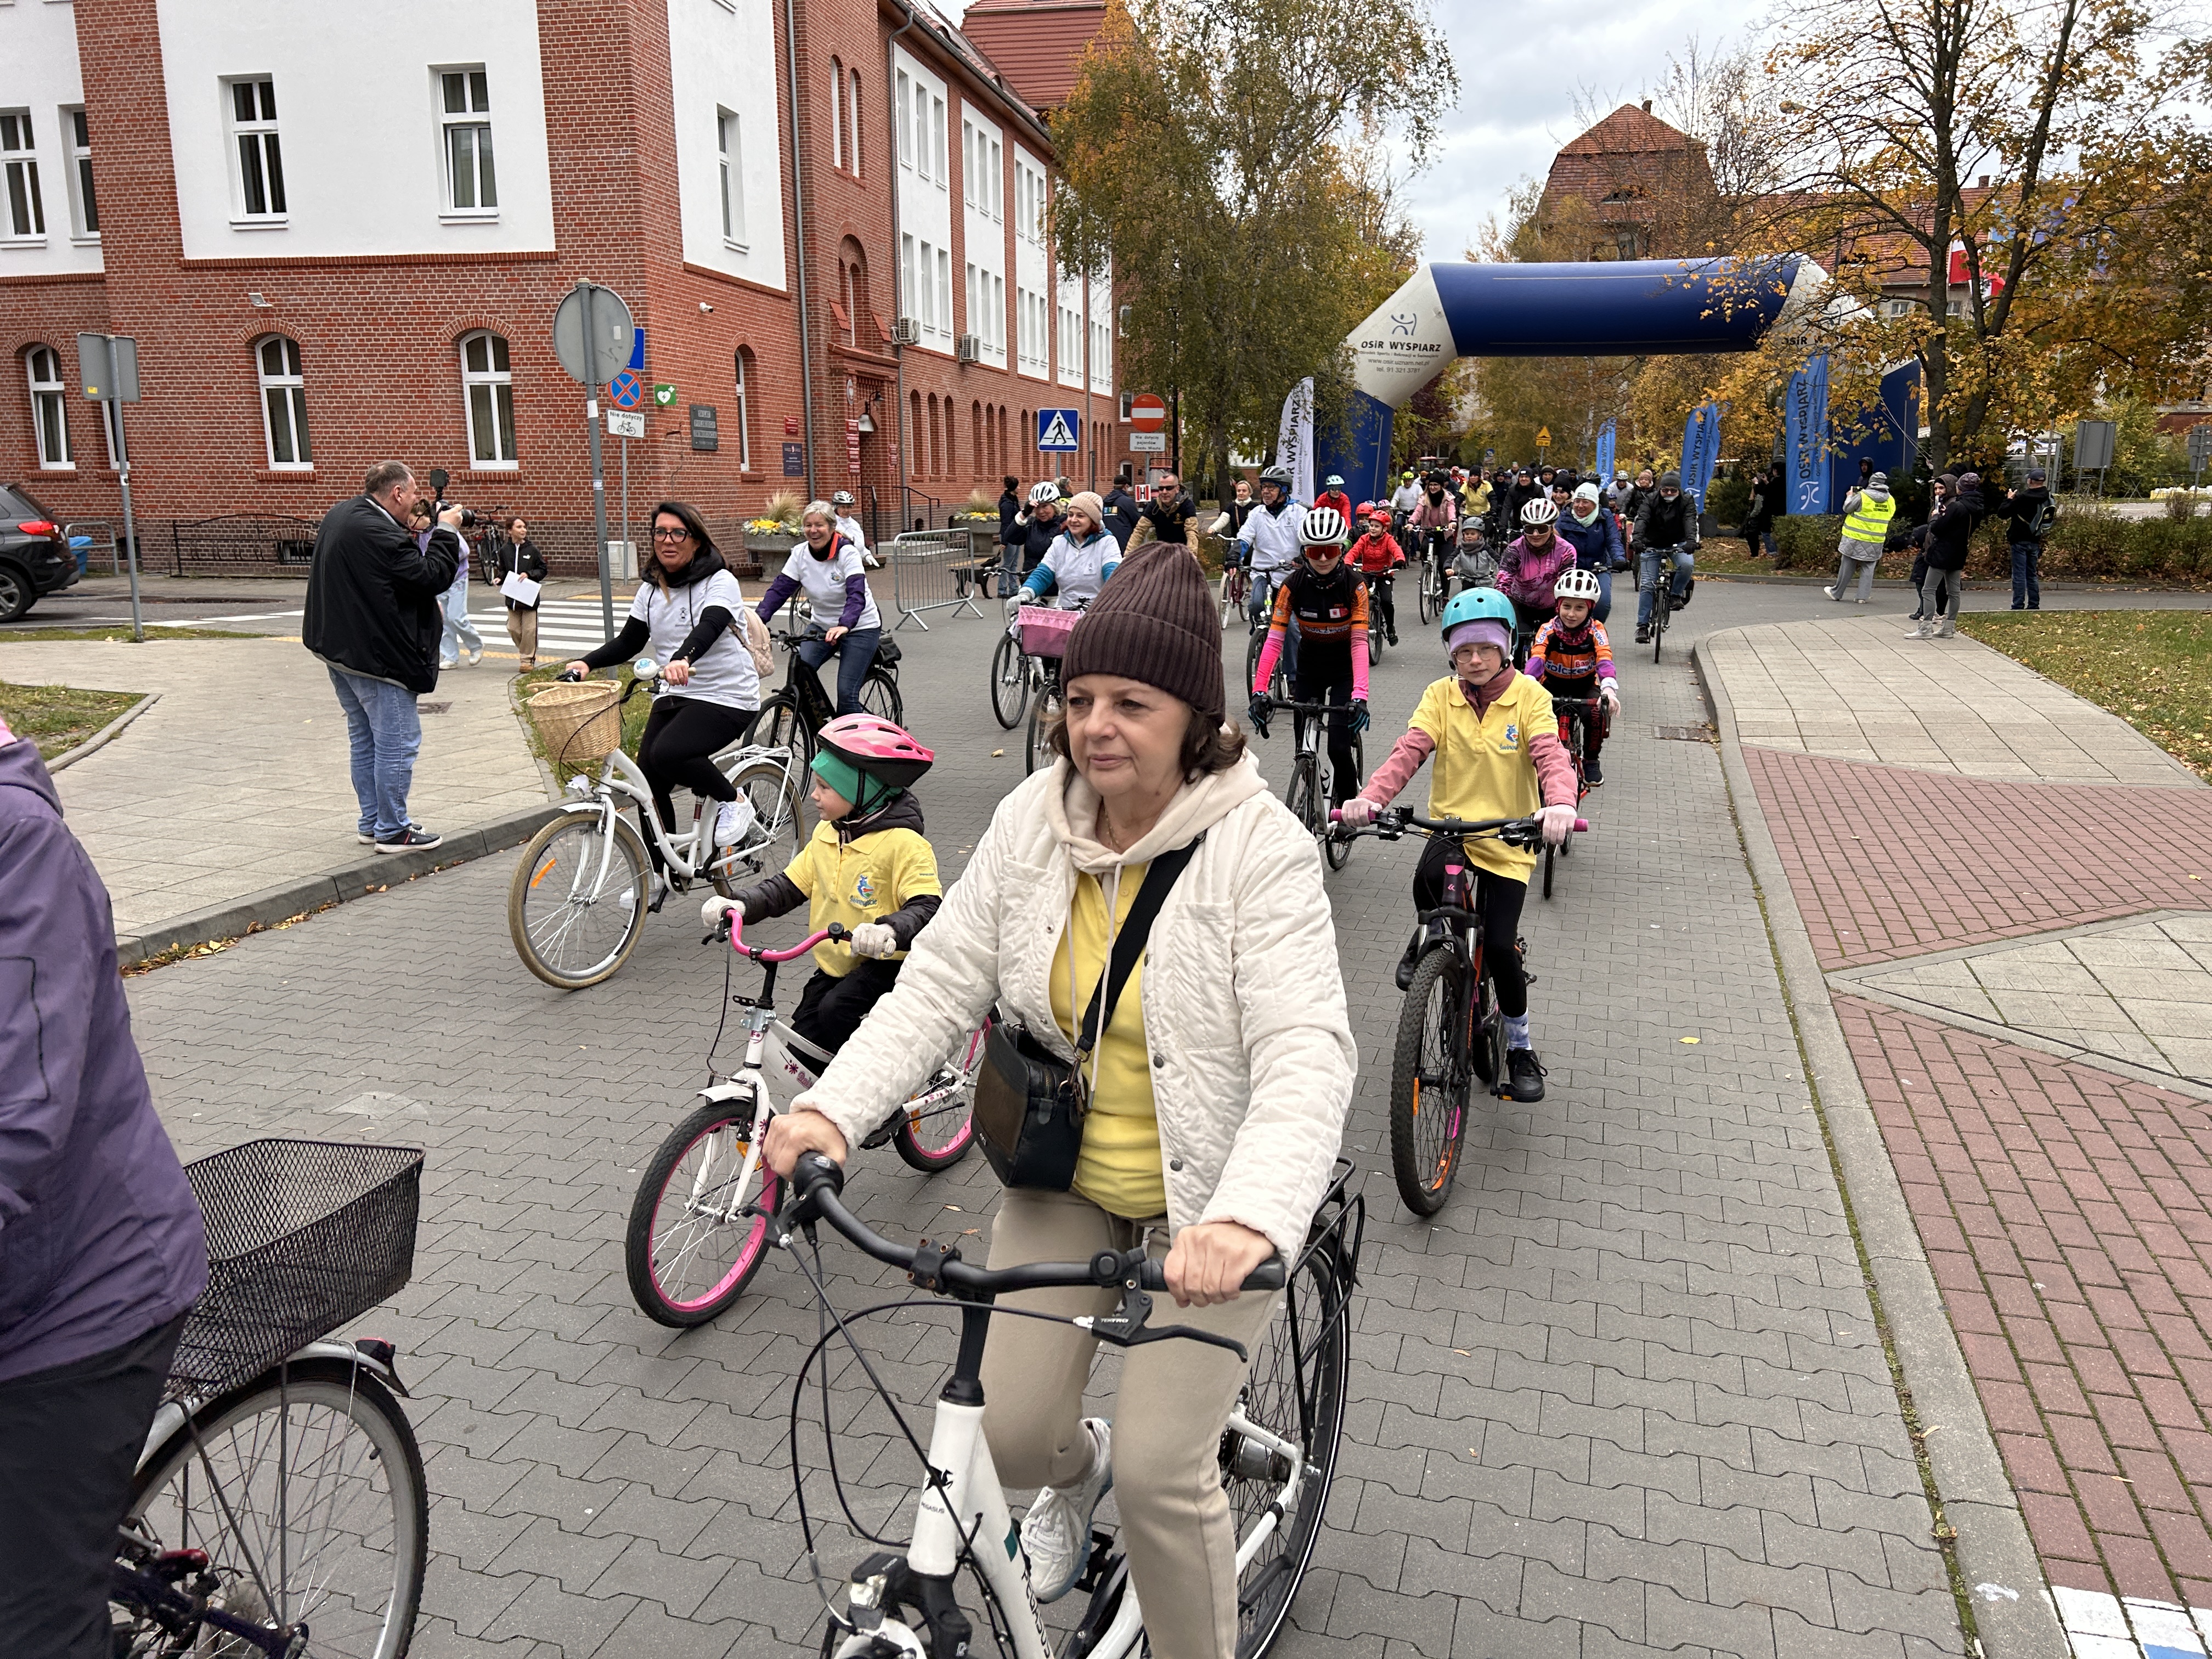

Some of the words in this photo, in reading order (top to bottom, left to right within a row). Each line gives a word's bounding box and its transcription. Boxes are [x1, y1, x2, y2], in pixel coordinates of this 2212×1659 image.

[1361, 340, 1384, 349] OSiR
[1389, 341, 1441, 352] WYSPIARZ
[622, 413, 642, 422] dotyczy
[1691, 411, 1707, 461] WYSPIAZ
